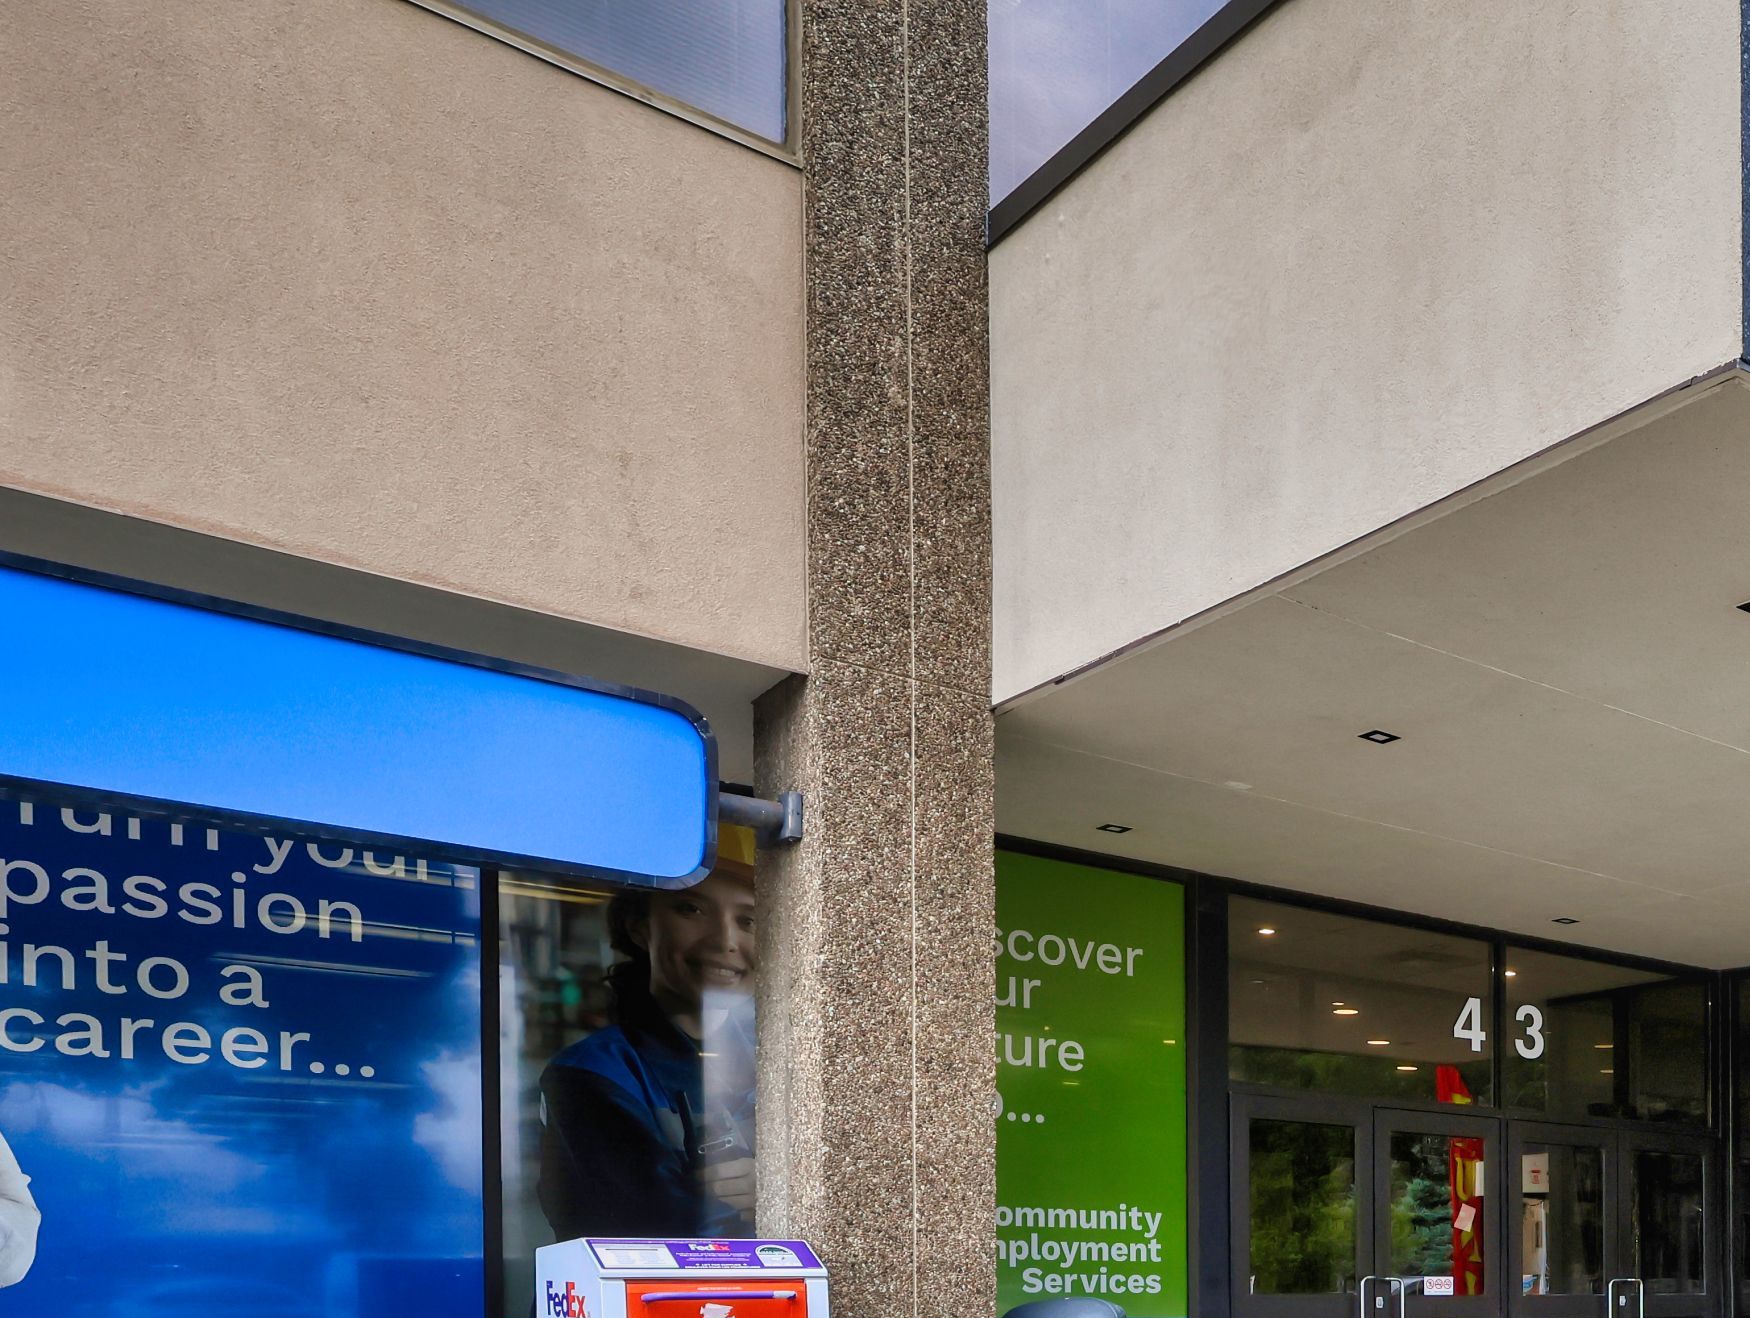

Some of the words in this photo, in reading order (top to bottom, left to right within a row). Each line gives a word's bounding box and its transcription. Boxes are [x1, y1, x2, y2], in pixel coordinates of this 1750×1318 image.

[0, 858, 364, 942] passion
[0, 923, 190, 1000] into
[219, 965, 270, 1009] a
[0, 1007, 376, 1079] career...
[1022, 1267, 1162, 1294] Services
